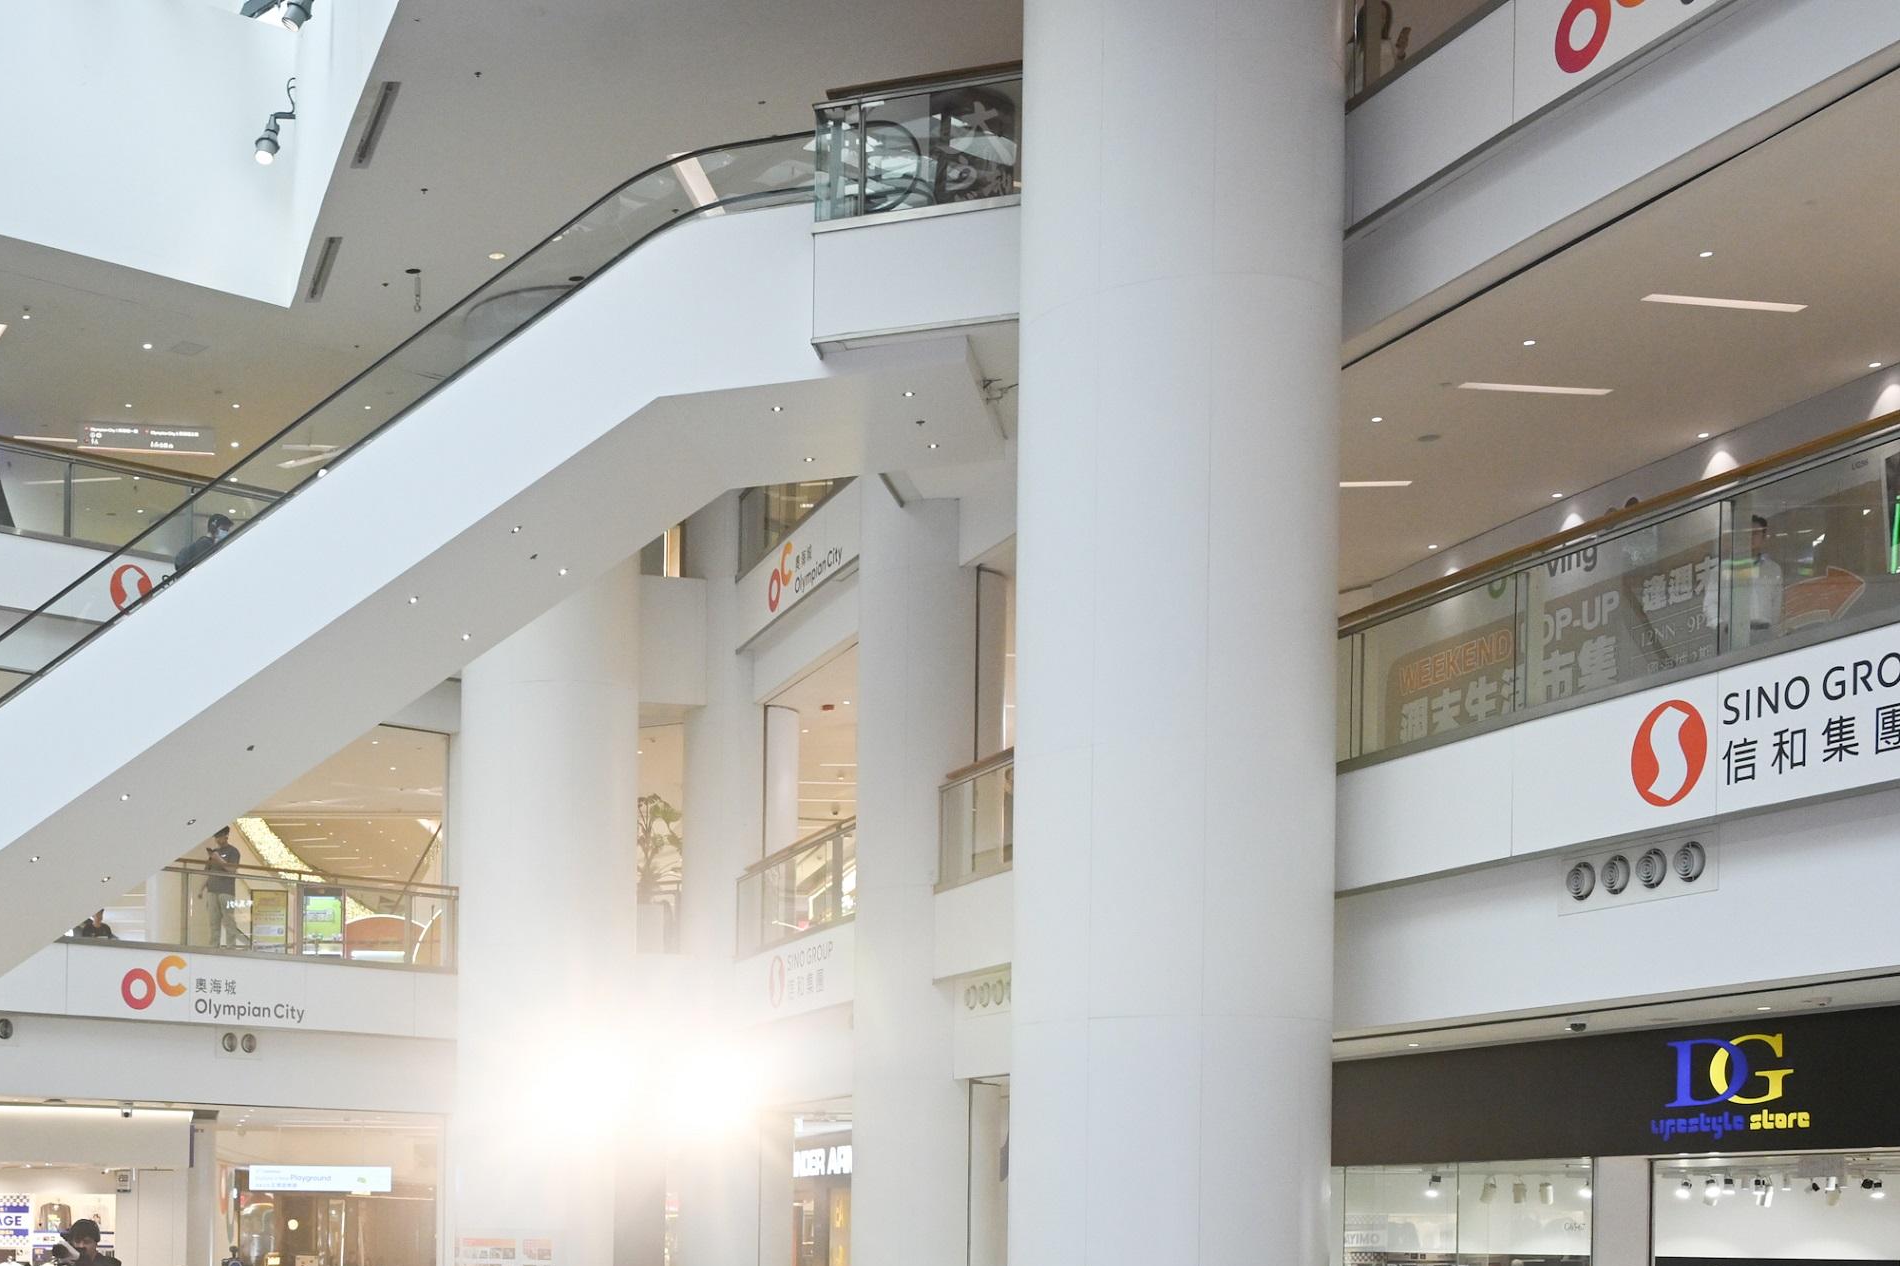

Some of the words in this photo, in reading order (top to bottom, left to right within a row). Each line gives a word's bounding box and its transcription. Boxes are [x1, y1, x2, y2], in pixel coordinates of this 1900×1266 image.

[1400, 628, 1513, 696] WEEKEND
[1722, 675, 1810, 725] SINO
[806, 940, 834, 965] GROUP
[195, 978, 237, 995] 奧海城
[194, 998, 271, 1020] Olympian
[274, 1003, 305, 1023] City
[1665, 1033, 1794, 1107] DG
[1750, 1109, 1811, 1130] store
[290, 1173, 332, 1183] Playground
